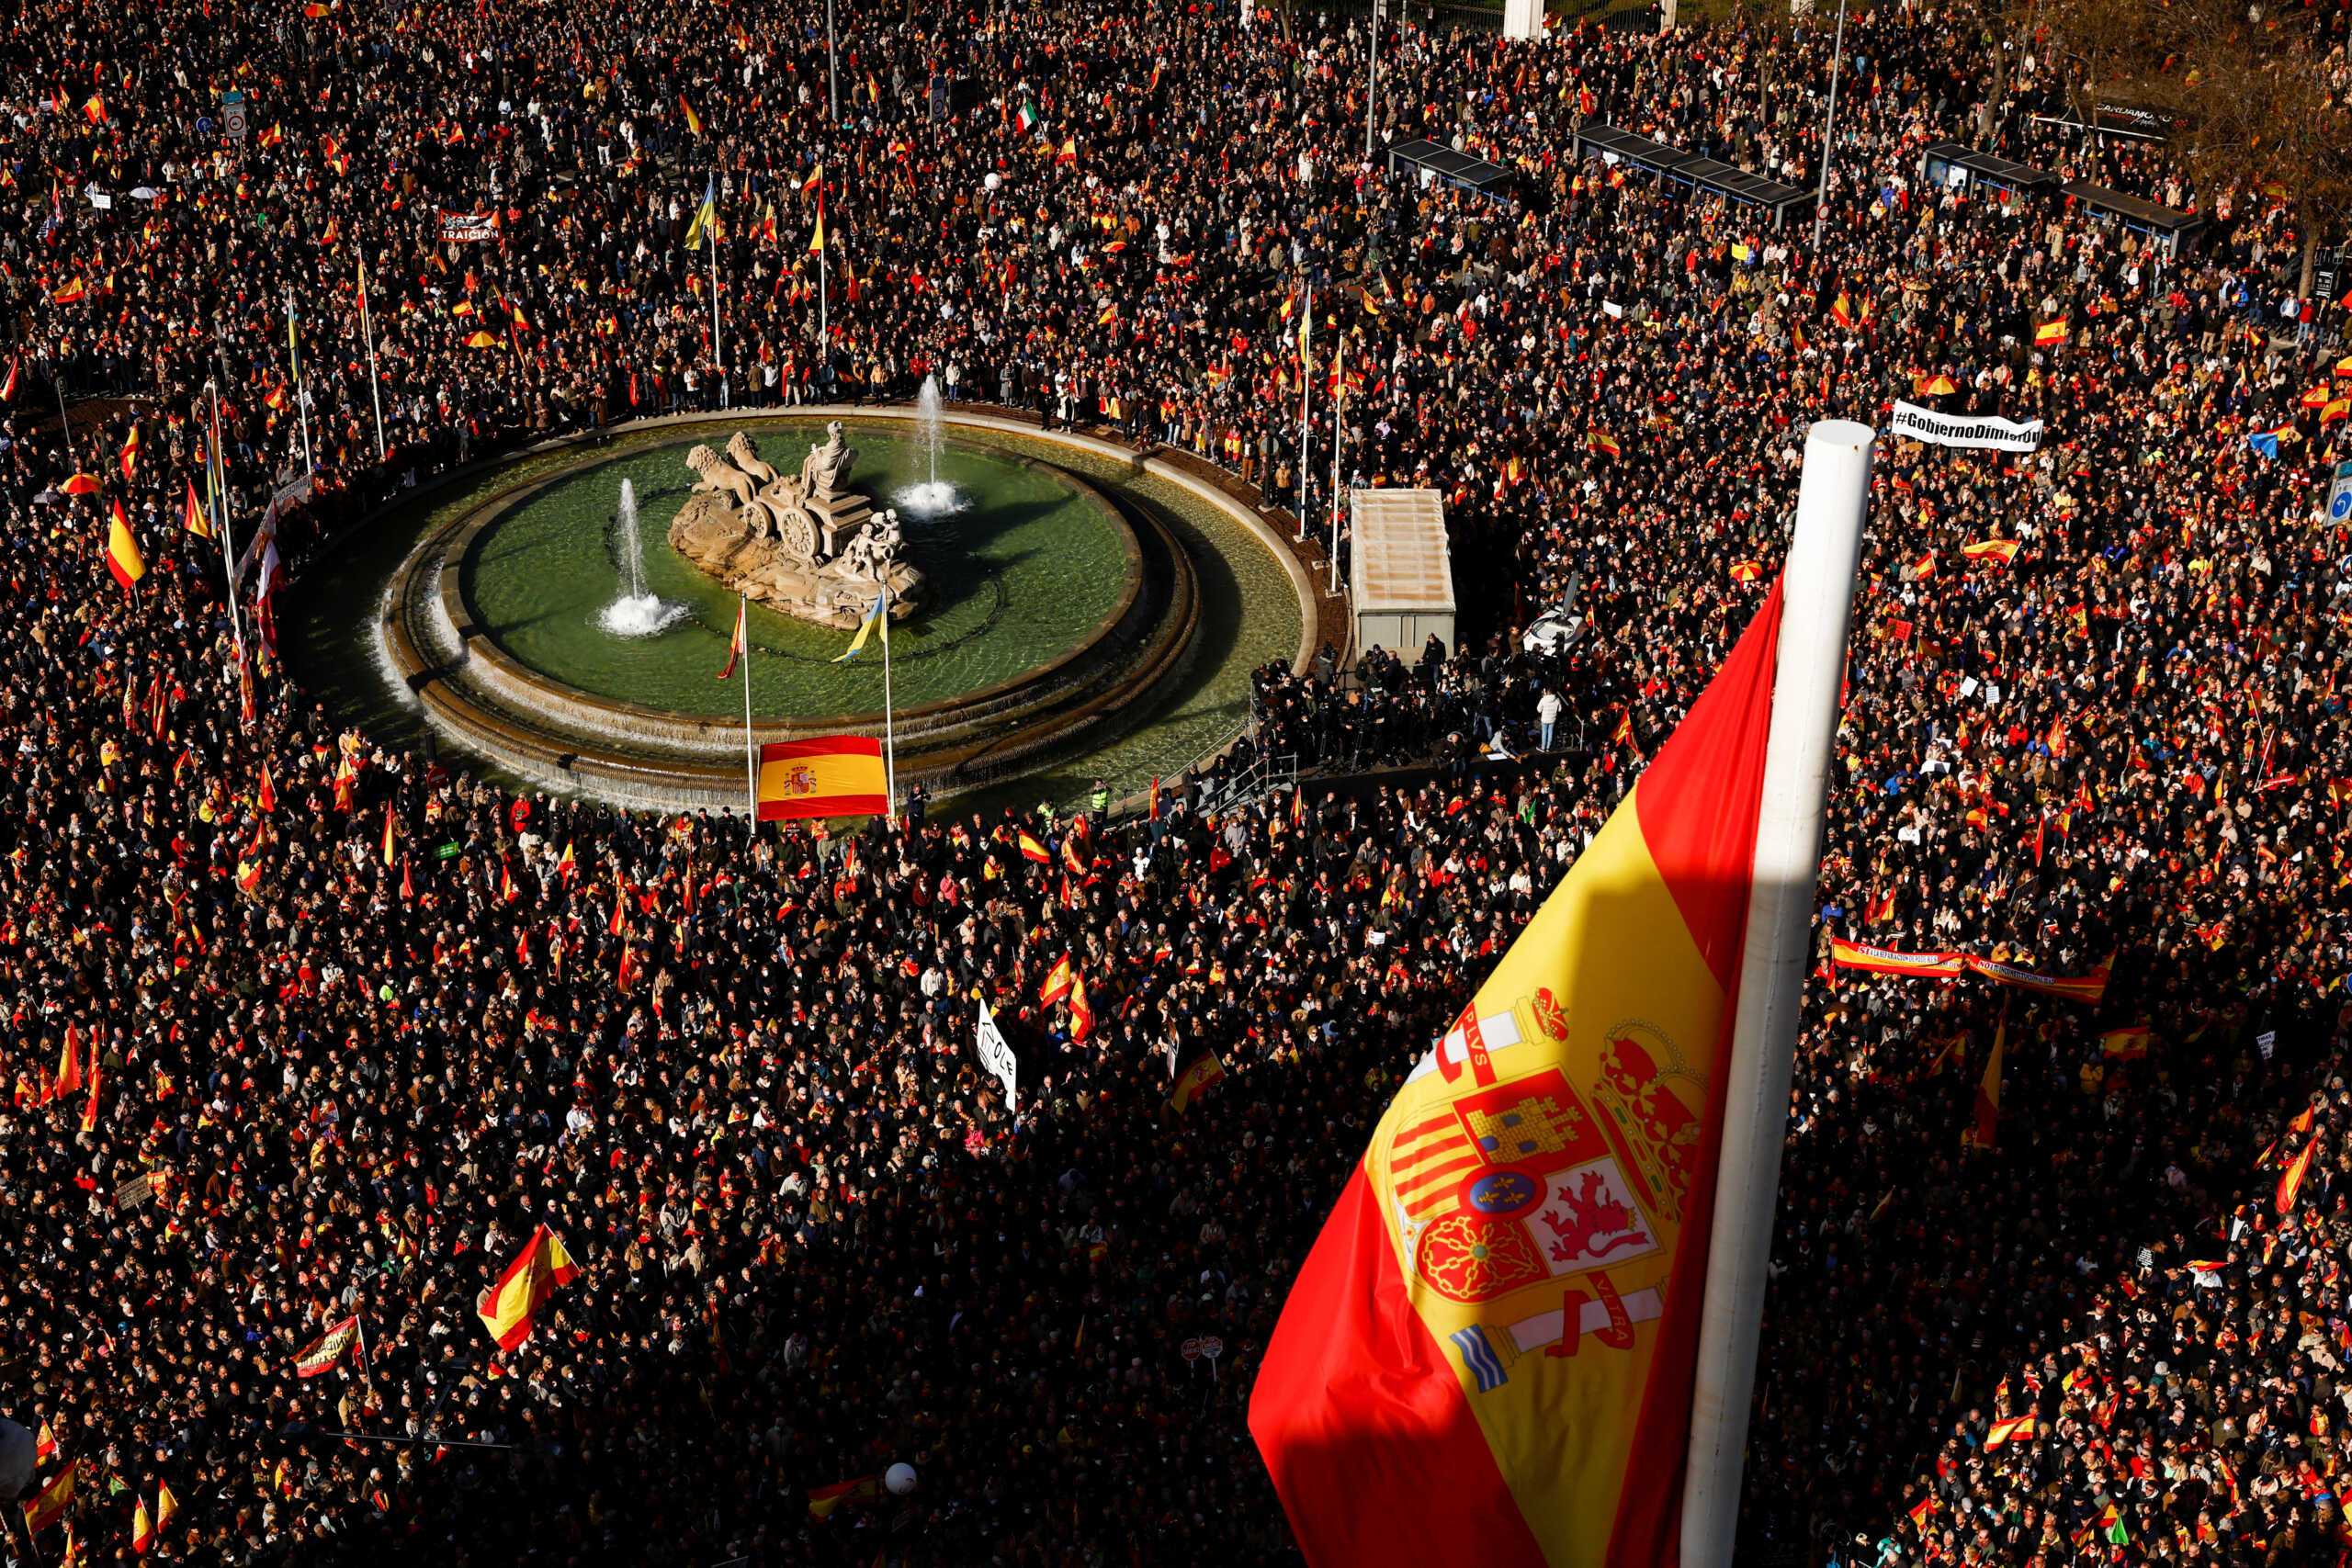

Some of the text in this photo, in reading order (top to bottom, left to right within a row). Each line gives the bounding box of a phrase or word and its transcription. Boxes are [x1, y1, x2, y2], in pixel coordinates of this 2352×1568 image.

[441, 229, 499, 240] TRAICIÓN
[1464, 1011, 1487, 1066] PLVS
[1597, 1279, 1629, 1341] VLTRA
